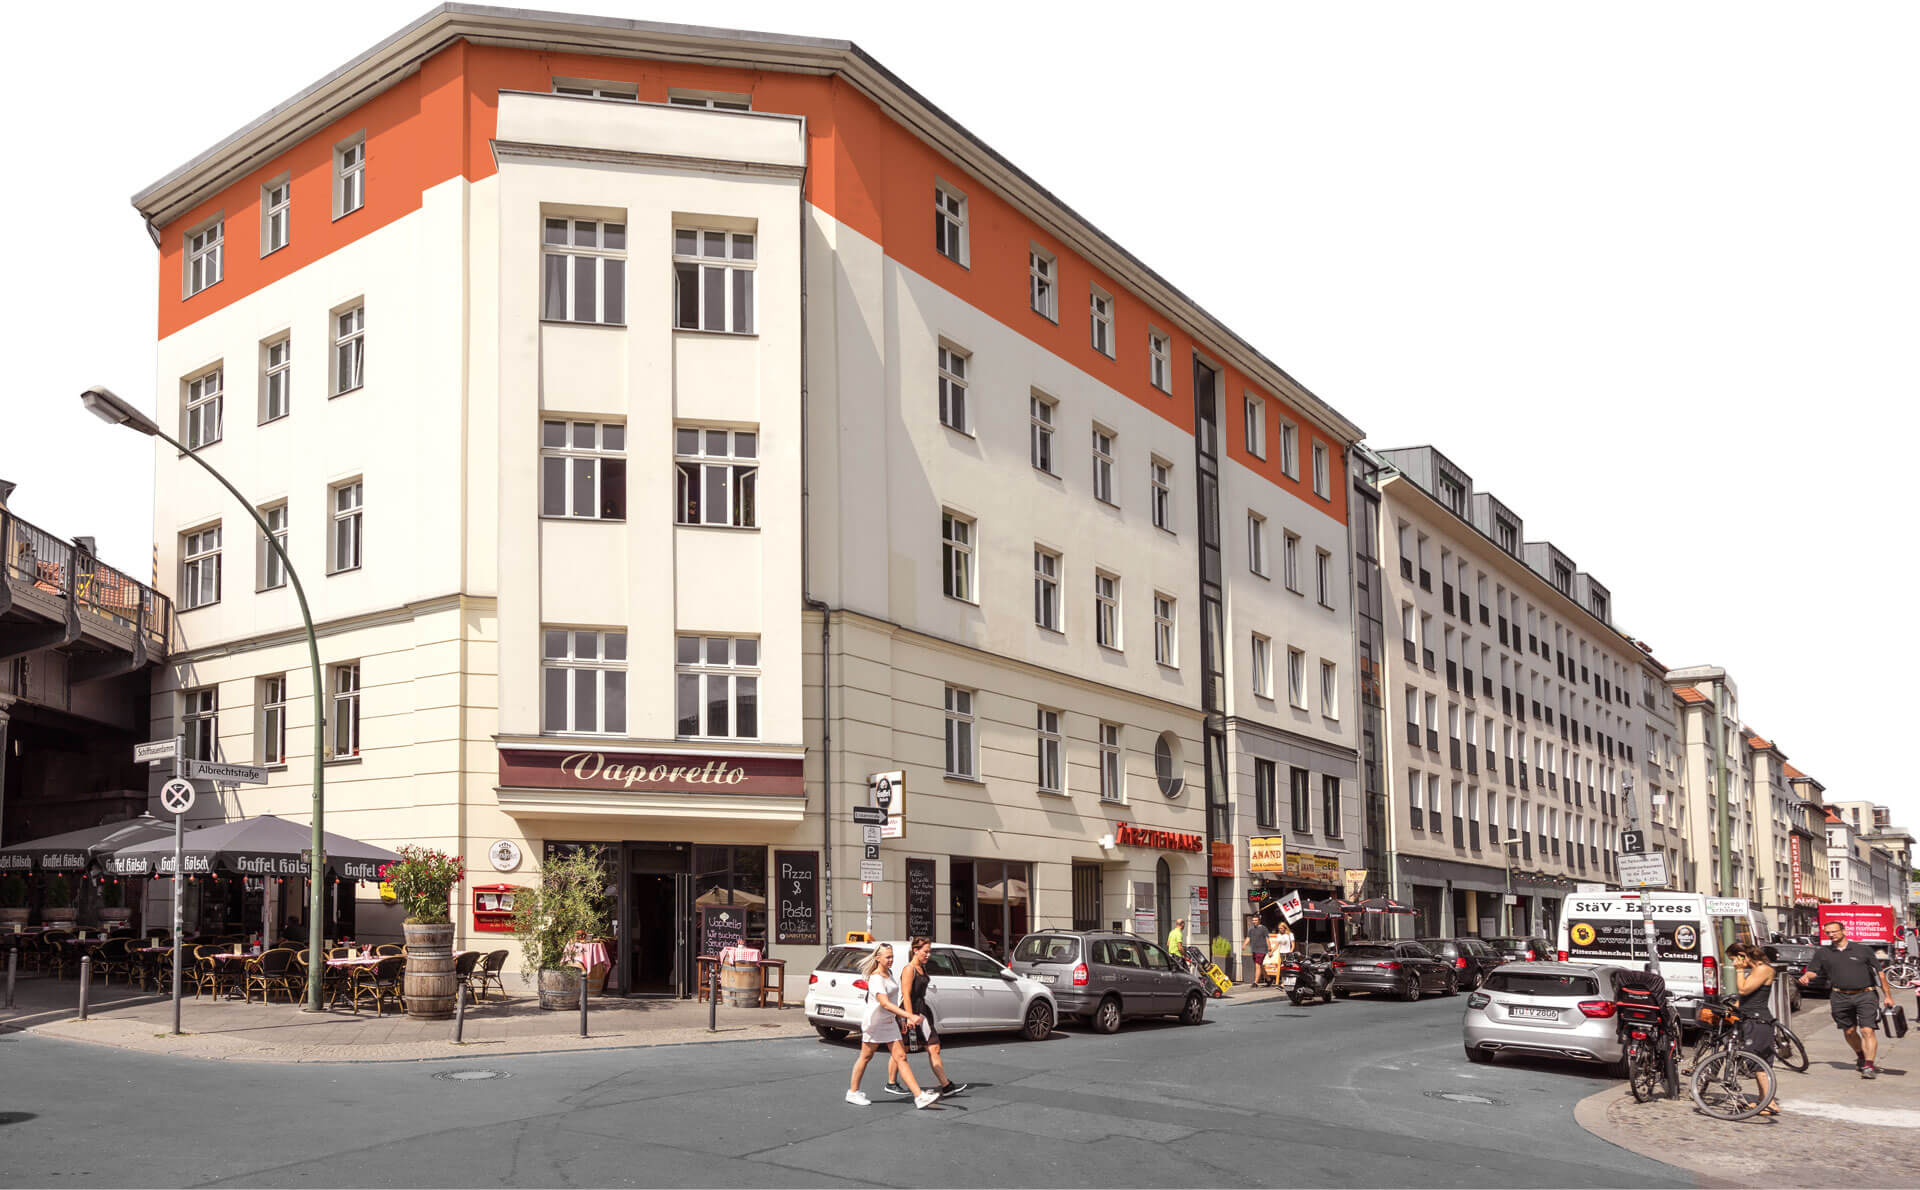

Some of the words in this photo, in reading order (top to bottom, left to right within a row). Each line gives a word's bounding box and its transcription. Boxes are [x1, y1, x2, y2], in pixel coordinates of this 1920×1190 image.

[198, 764, 260, 780] Albrechtstraße
[560, 752, 749, 788] Vaporetto
[1115, 821, 1203, 852] ÄRZTEHAUS
[1624, 834, 1637, 851] P
[867, 846, 876, 858] P
[1252, 849, 1281, 860] ANAND
[42, 854, 62, 868] Gaffel
[238, 856, 277, 873] Gaffel
[279, 858, 311, 874] Köls
[344, 862, 376, 878] Gaffel
[792, 880, 802, 896] &
[782, 900, 812, 919] Pasta
[1283, 896, 1301, 913] EIS
[1576, 902, 1612, 913] StäV
[1663, 952, 1698, 960] Catering
